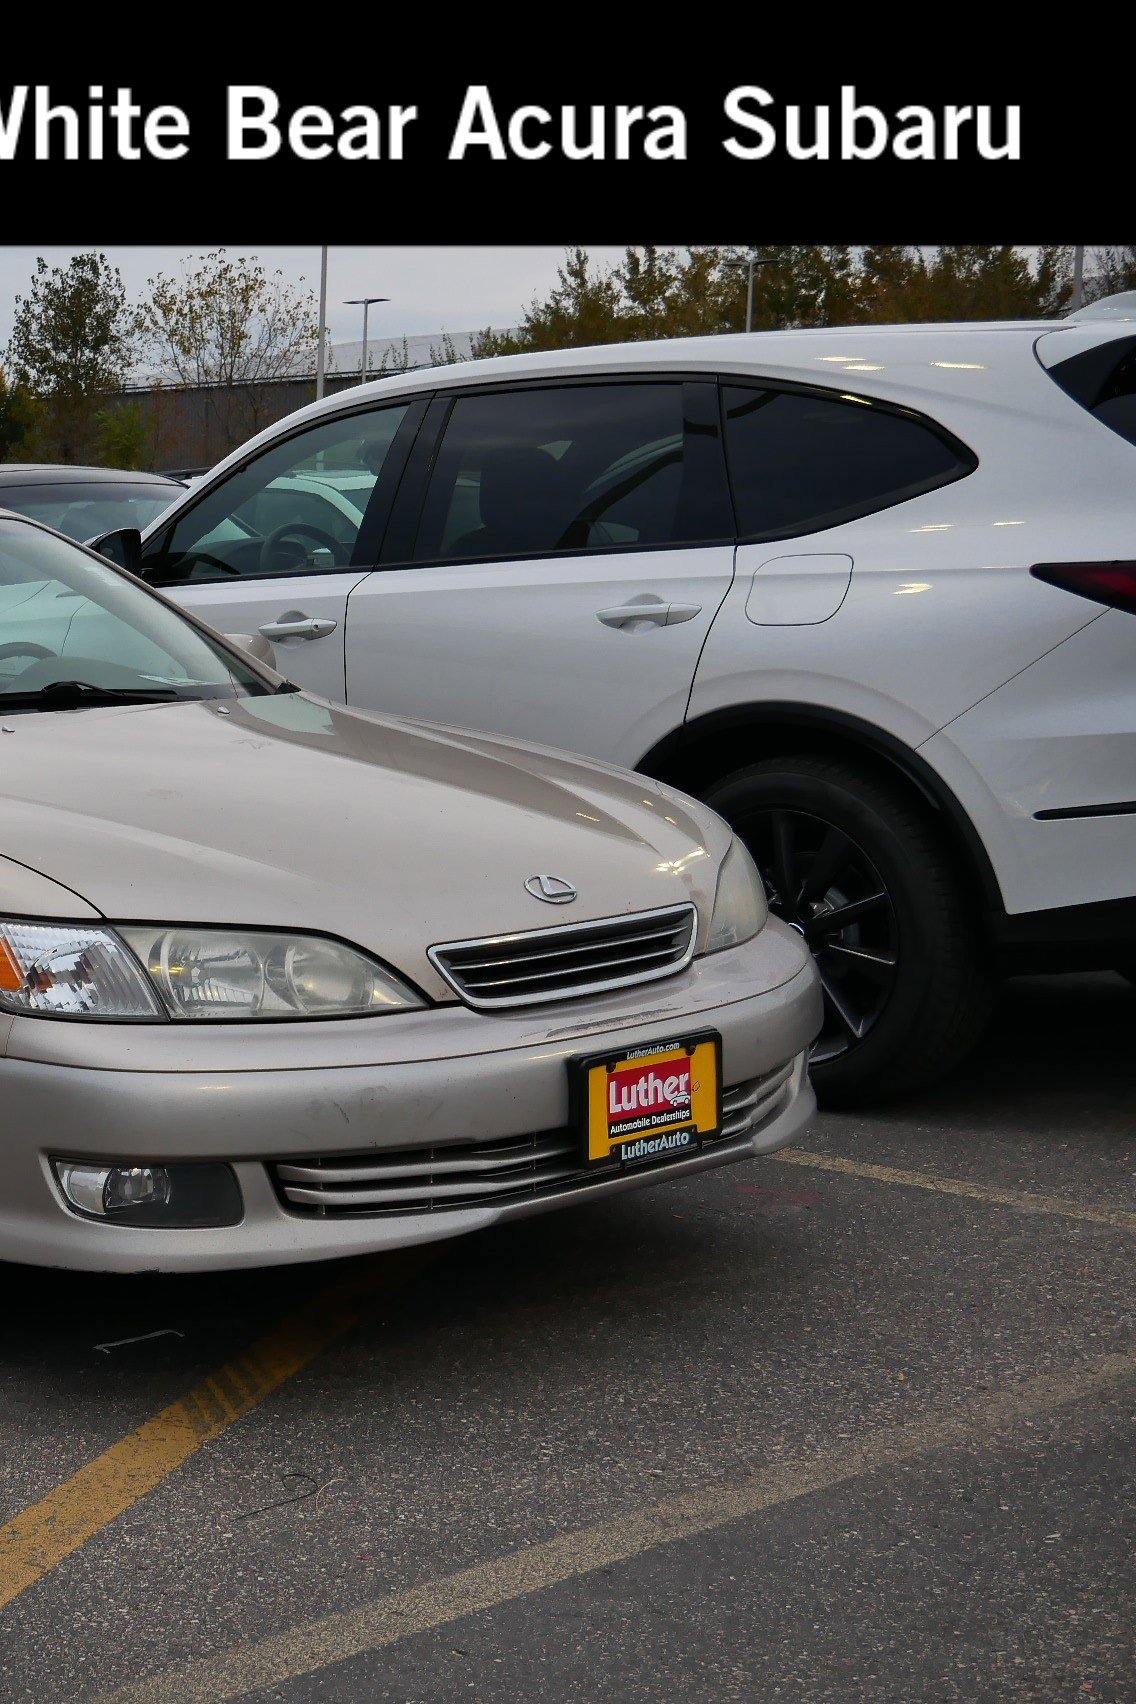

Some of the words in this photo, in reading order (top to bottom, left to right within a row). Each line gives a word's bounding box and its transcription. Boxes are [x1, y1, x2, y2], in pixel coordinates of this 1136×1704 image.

[626, 1043, 680, 1060] LutherAuto.com
[610, 1072, 689, 1113] Luther
[610, 1119, 650, 1134] Automobile
[651, 1109, 690, 1124] Dealerships
[621, 1132, 689, 1160] LutherAuto
